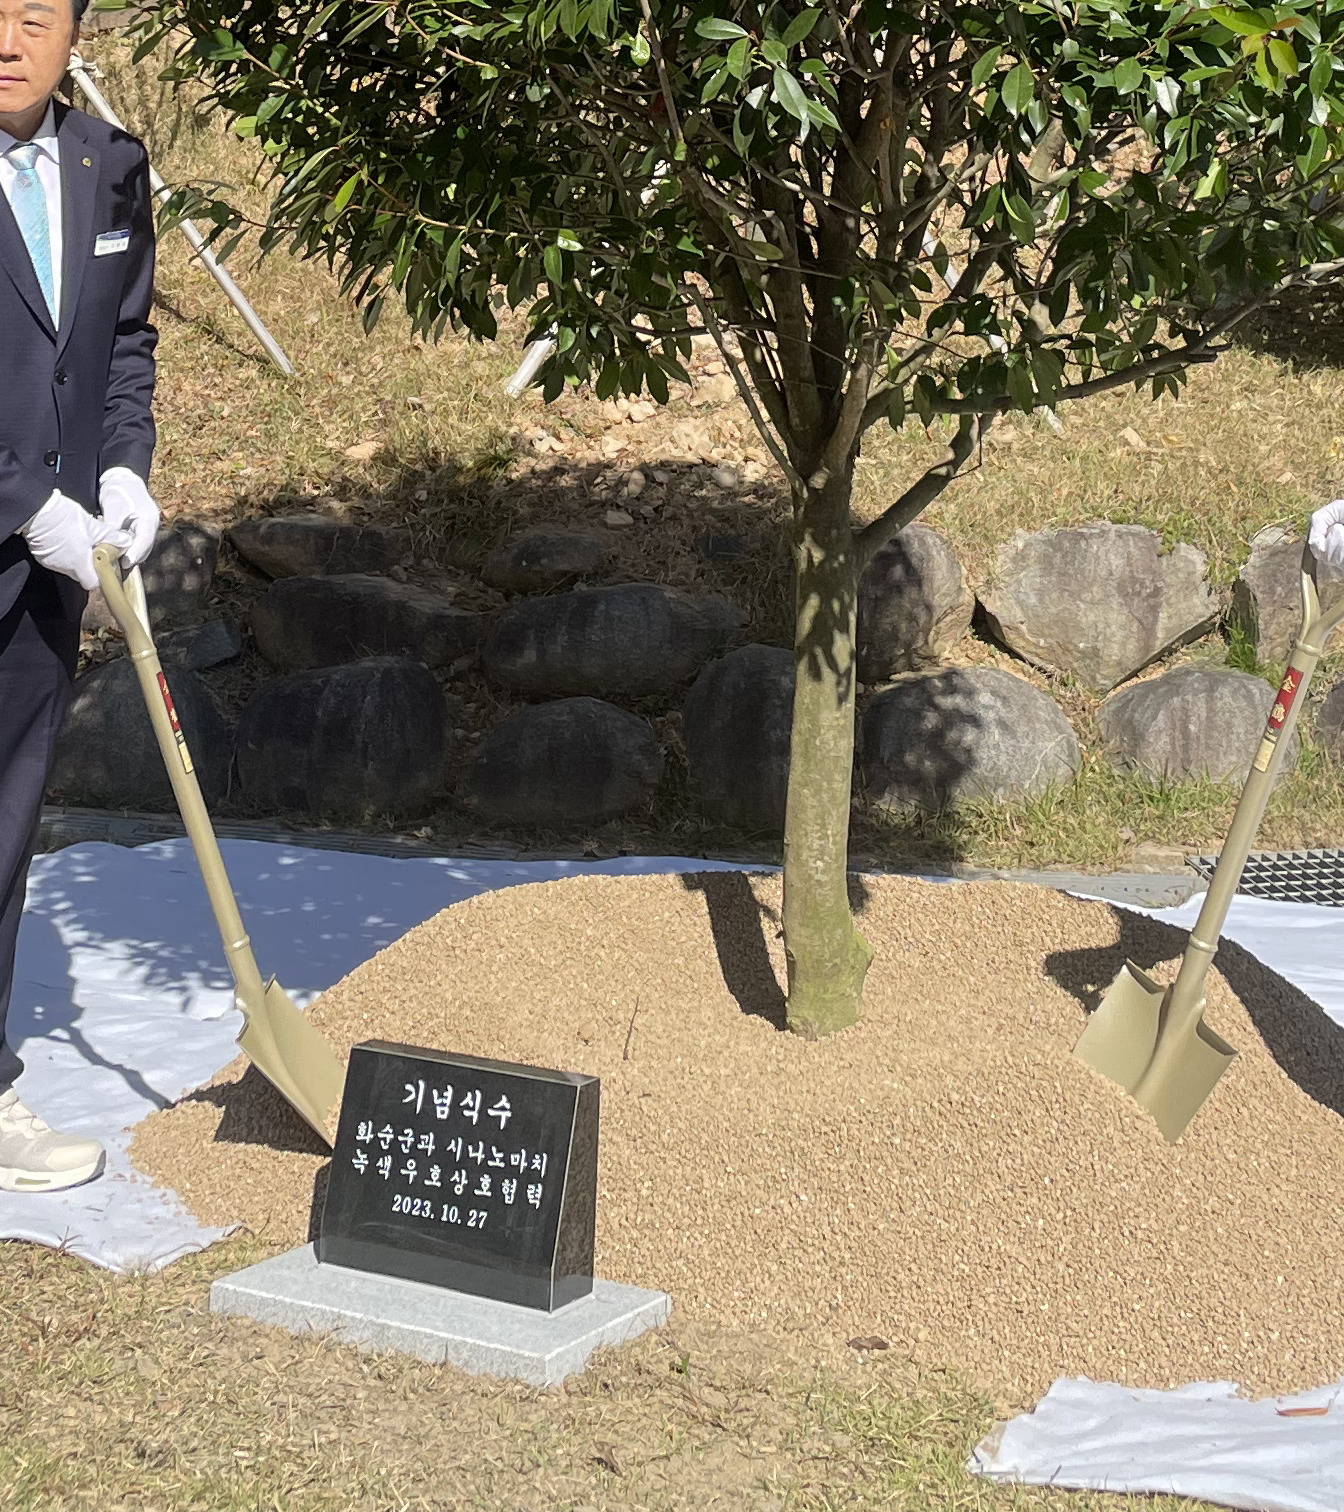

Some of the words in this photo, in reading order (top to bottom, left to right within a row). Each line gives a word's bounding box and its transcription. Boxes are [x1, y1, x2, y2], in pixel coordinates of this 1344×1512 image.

[402, 1079, 512, 1130] 기념식수
[356, 1120, 435, 1157] 화순군과
[446, 1136, 548, 1178] 시나노마치
